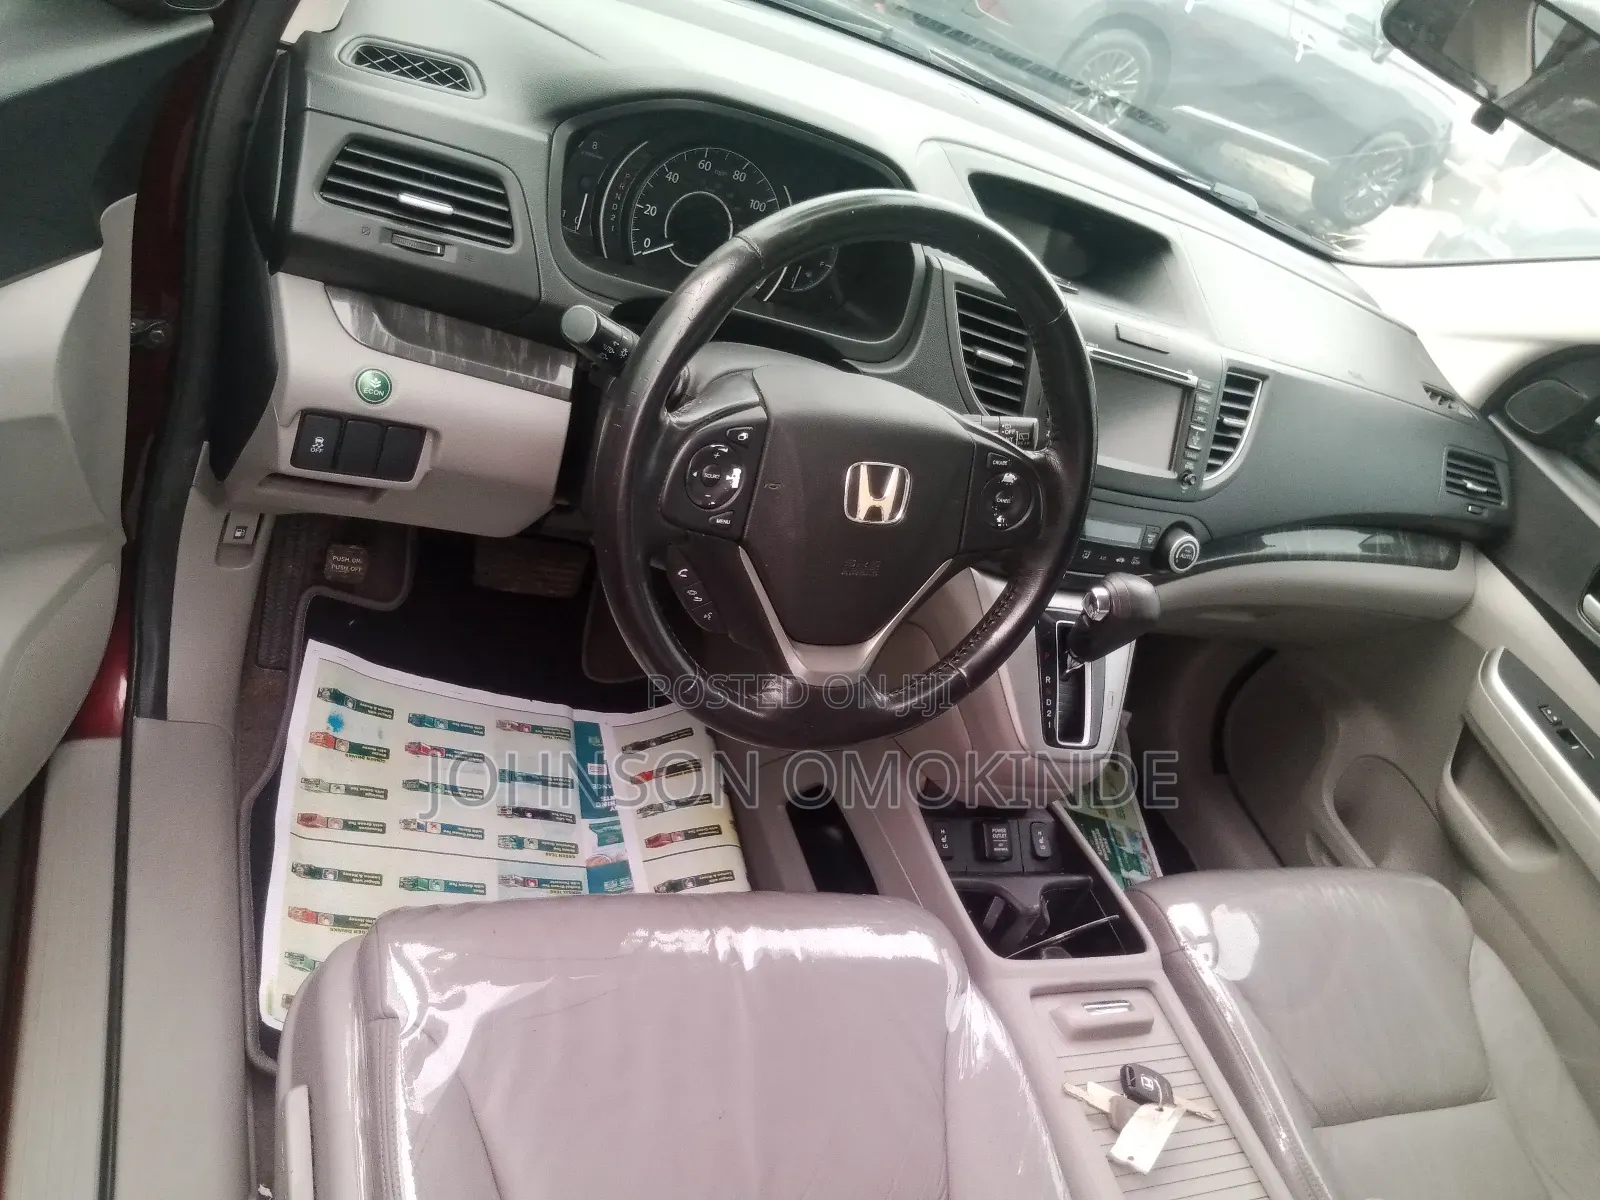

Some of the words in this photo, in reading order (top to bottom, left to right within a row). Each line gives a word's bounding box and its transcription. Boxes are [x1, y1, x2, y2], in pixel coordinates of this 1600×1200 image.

[698, 160, 712, 172] 60
[665, 172, 680, 184] 40
[732, 170, 746, 182] 80
[644, 204, 657, 216] 20
[750, 199, 766, 212] 100
[644, 238, 651, 248] 0
[364, 387, 384, 397] ECON
